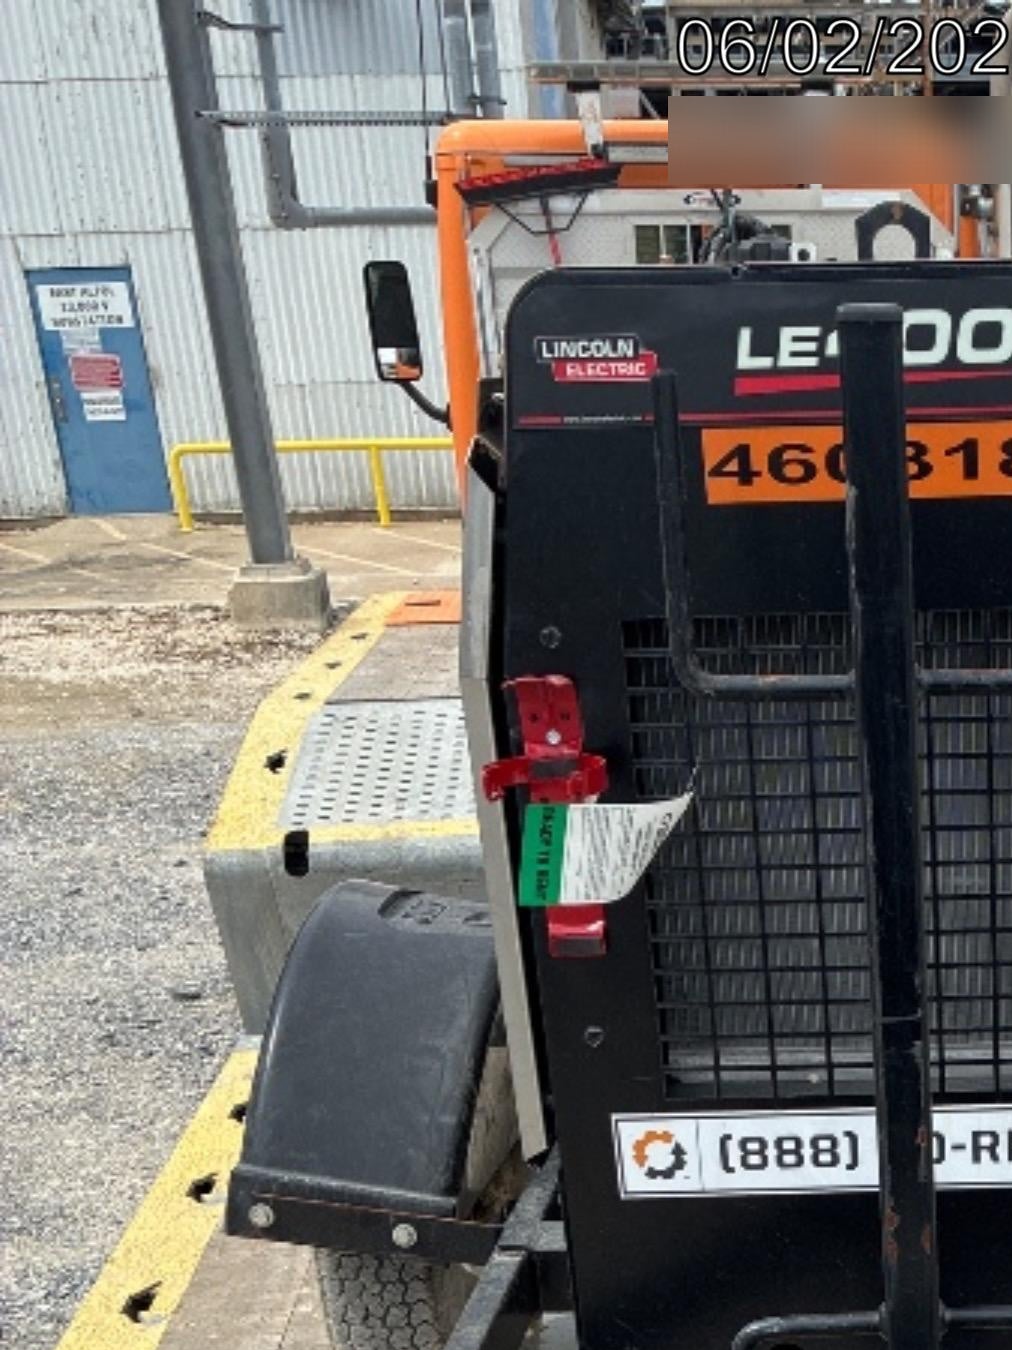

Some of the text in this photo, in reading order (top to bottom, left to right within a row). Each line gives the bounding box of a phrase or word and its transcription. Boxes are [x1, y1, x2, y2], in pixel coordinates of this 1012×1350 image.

[540, 338, 634, 359] LINCOLN
[565, 361, 647, 377] ELECTRIC
[719, 1130, 859, 1174] (888)
